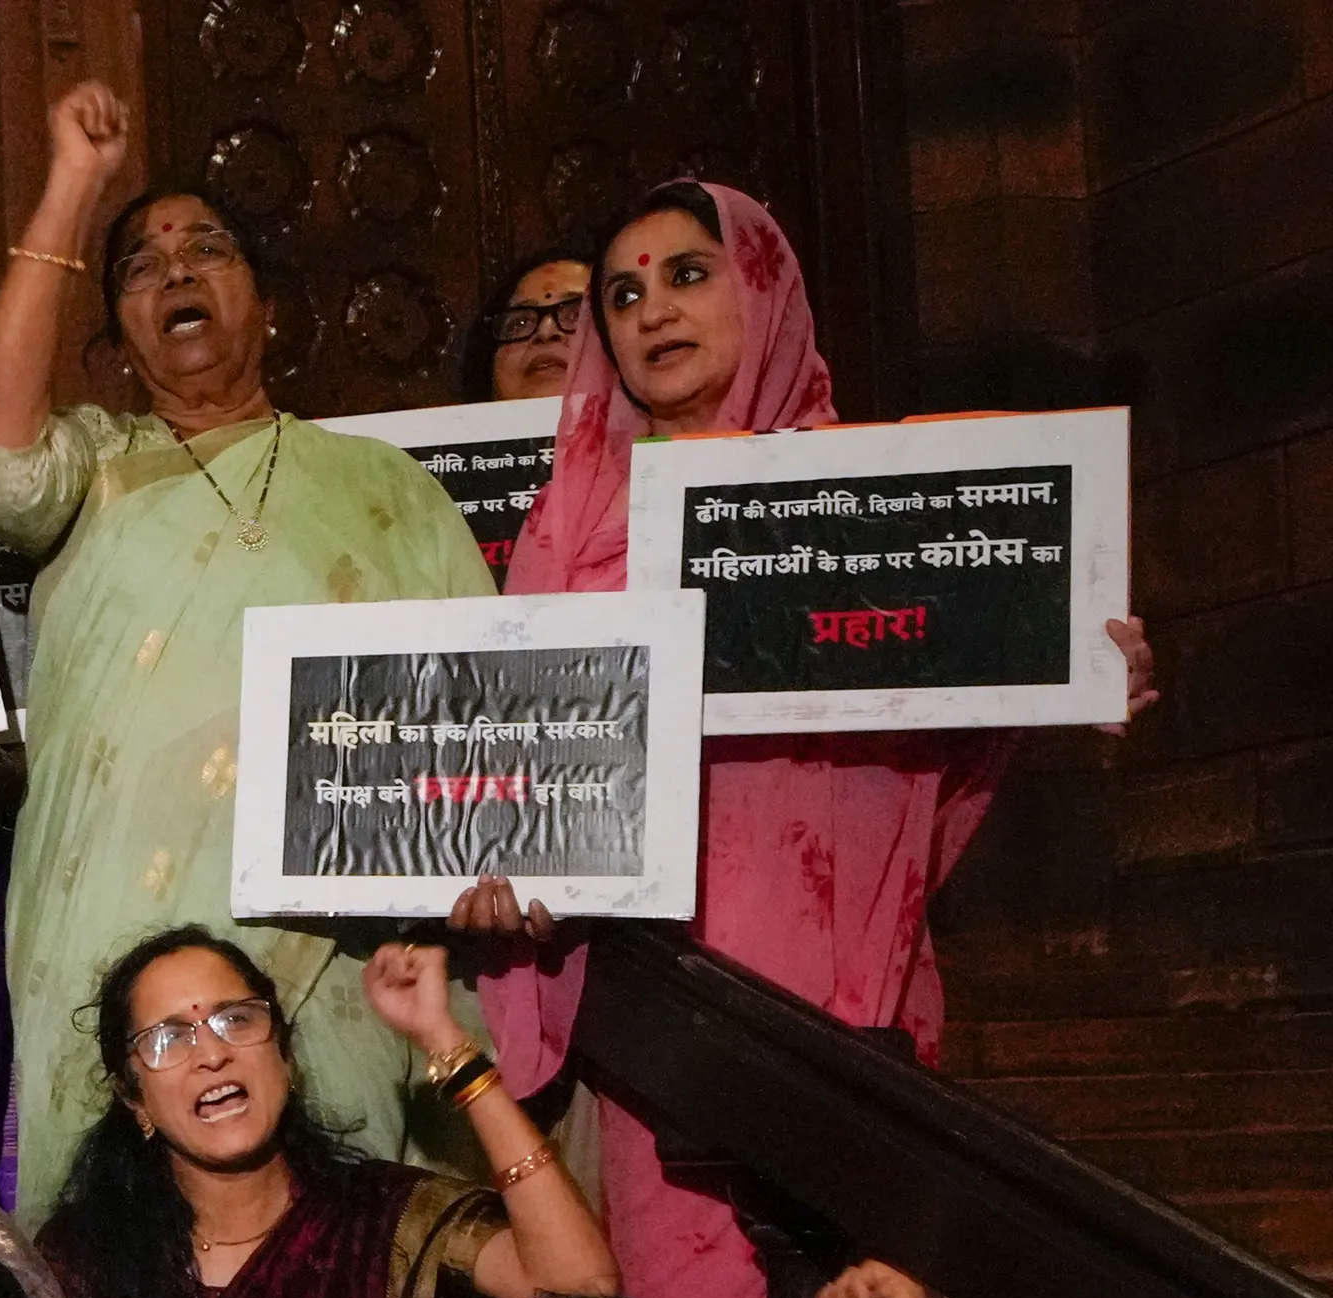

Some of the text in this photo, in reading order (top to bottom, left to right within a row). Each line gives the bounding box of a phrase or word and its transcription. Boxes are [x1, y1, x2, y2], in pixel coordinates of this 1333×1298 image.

[472, 453, 514, 470] दिखावे
[518, 455, 535, 466] का
[483, 498, 506, 512] पर
[695, 481, 1059, 524] ढोंग की राजनीति, दिखावे का सम्मान,
[688, 530, 1063, 581] महिलाओं के हक़ पर कांग्रेस का
[809, 606, 927, 648] प्रहार!
[308, 711, 625, 748] महिला का हक दिलाए सरकार,
[314, 779, 374, 808] विपक्ष
[377, 779, 408, 804] बने
[534, 783, 561, 805] हर
[567, 781, 614, 802] बार!
